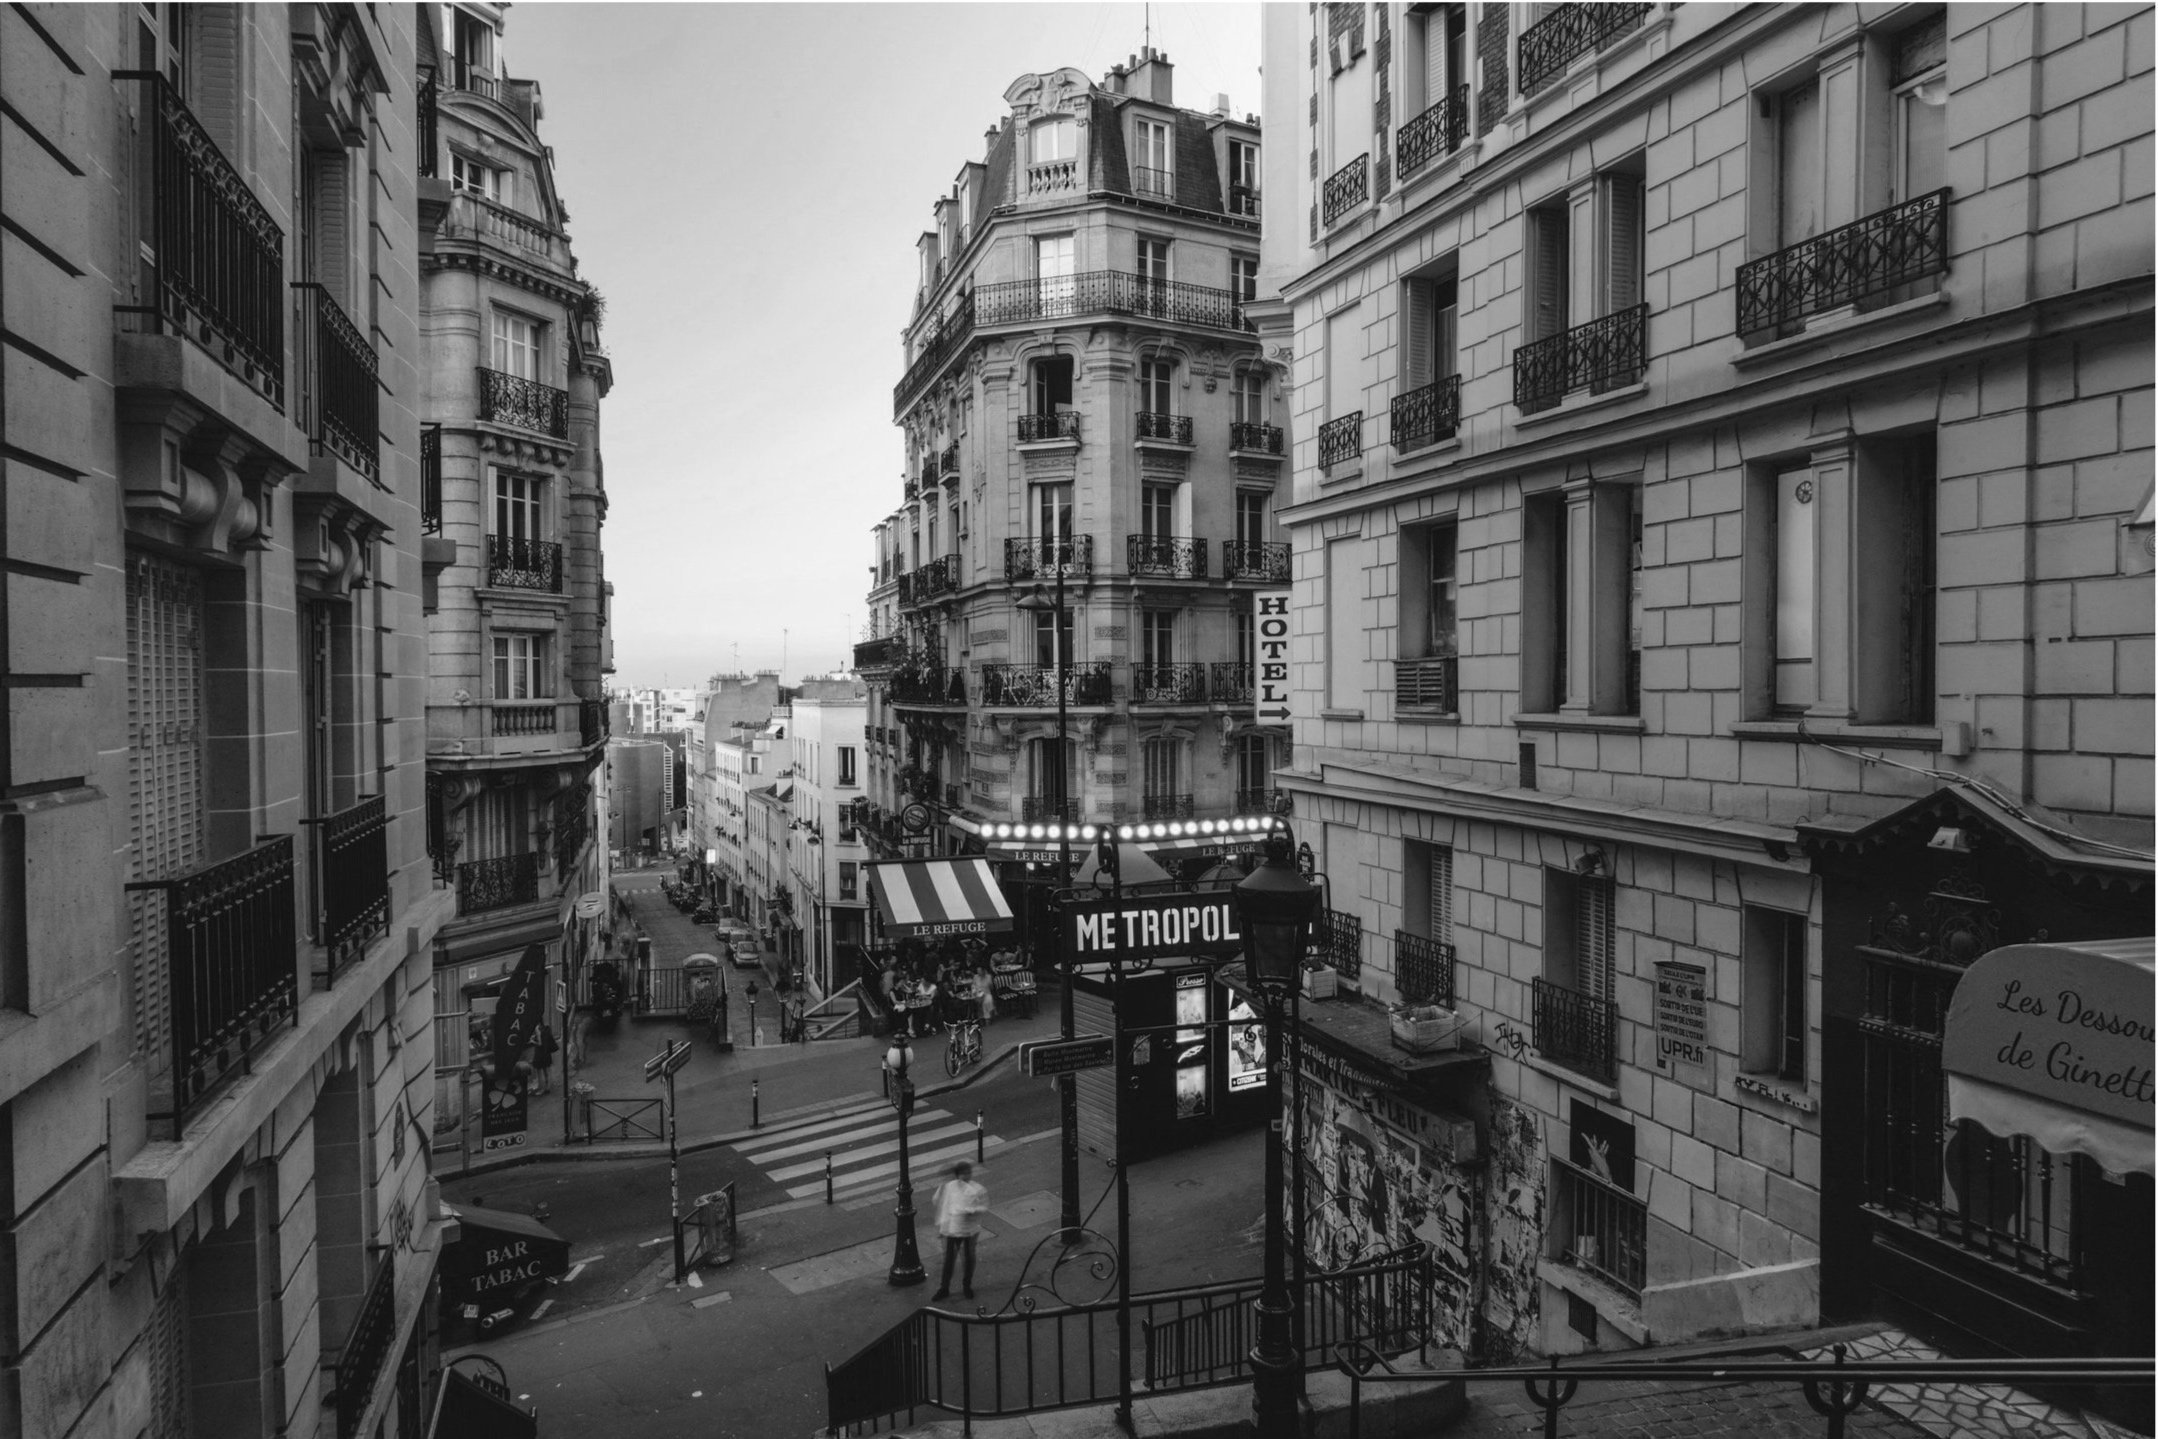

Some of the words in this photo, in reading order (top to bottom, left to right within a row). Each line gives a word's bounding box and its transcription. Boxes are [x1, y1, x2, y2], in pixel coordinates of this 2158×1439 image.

[1259, 597, 1289, 702] HOTEL
[1015, 851, 1030, 861] LE
[1033, 852, 1080, 862] REFUE
[1202, 847, 1215, 856] LE
[913, 925, 931, 936] LE
[933, 922, 986, 935] REFUGE
[1076, 904, 1241, 952] METROPOL
[507, 971, 536, 1046] TABAC
[1997, 979, 2047, 1016] Les
[2057, 990, 2155, 1042] Dessou
[1997, 1031, 2035, 1070] de
[2046, 1041, 2155, 1104] Ginett
[487, 1134, 526, 1150] LOTO
[486, 1240, 529, 1266] BAR
[471, 1260, 541, 1292] TABAC
